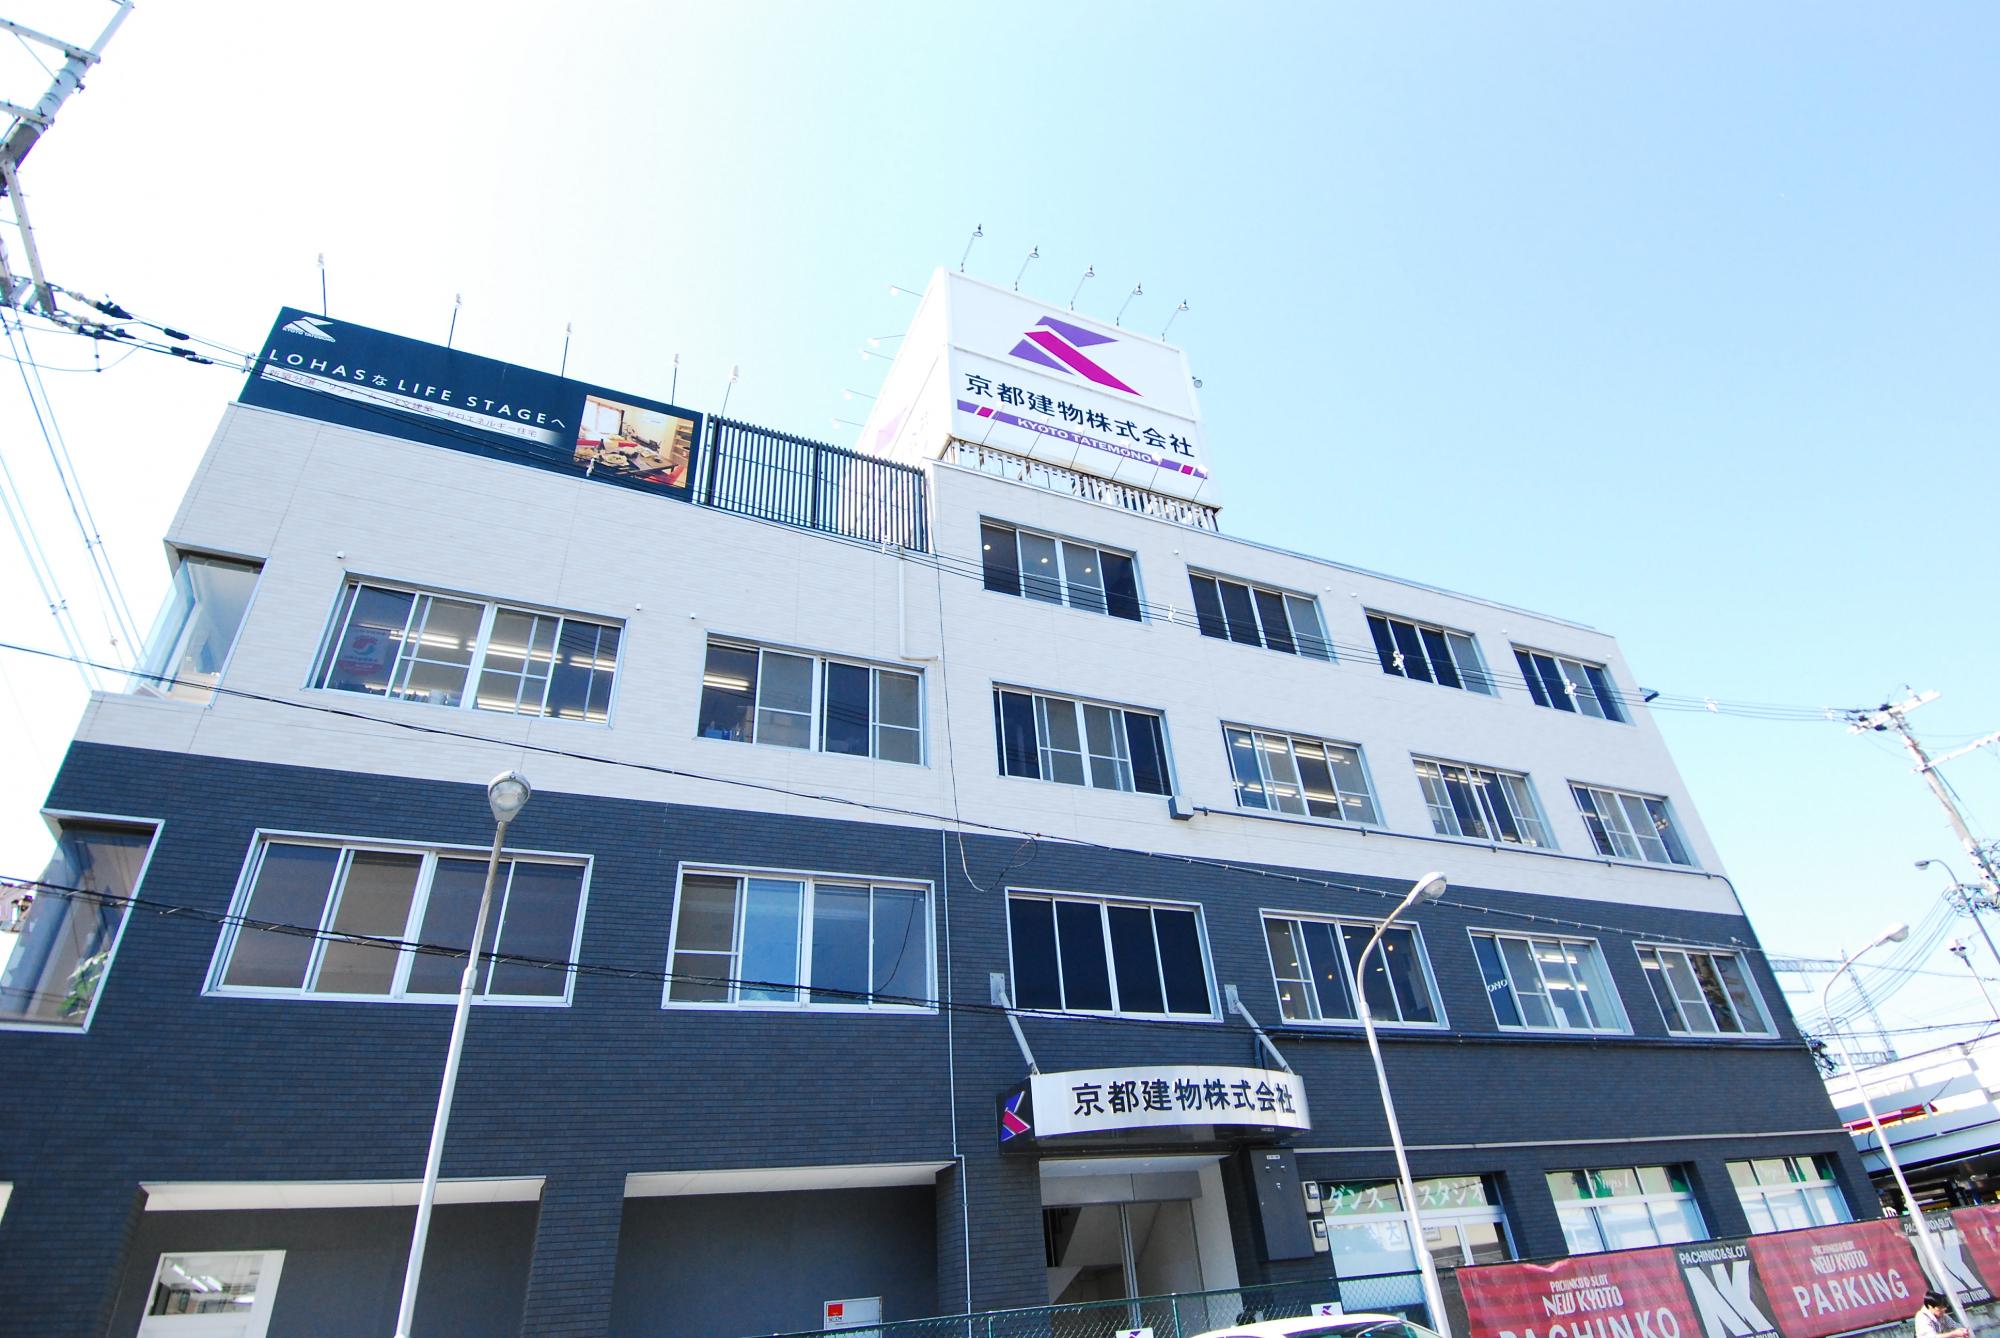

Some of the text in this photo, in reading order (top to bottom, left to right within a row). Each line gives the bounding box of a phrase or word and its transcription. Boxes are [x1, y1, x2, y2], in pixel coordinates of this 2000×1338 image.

[397, 379, 452, 401] LIFE
[964, 373, 1195, 458] 京都建物株式会社
[1017, 418, 1152, 463] KYOTO TATEMONO
[1071, 1078, 1297, 1117] 京都建物株式会社
[1836, 1249, 1869, 1272] KYOTO
[1541, 1285, 1624, 1318] NEW KYOTO
[1792, 1268, 1910, 1319] PARKING
